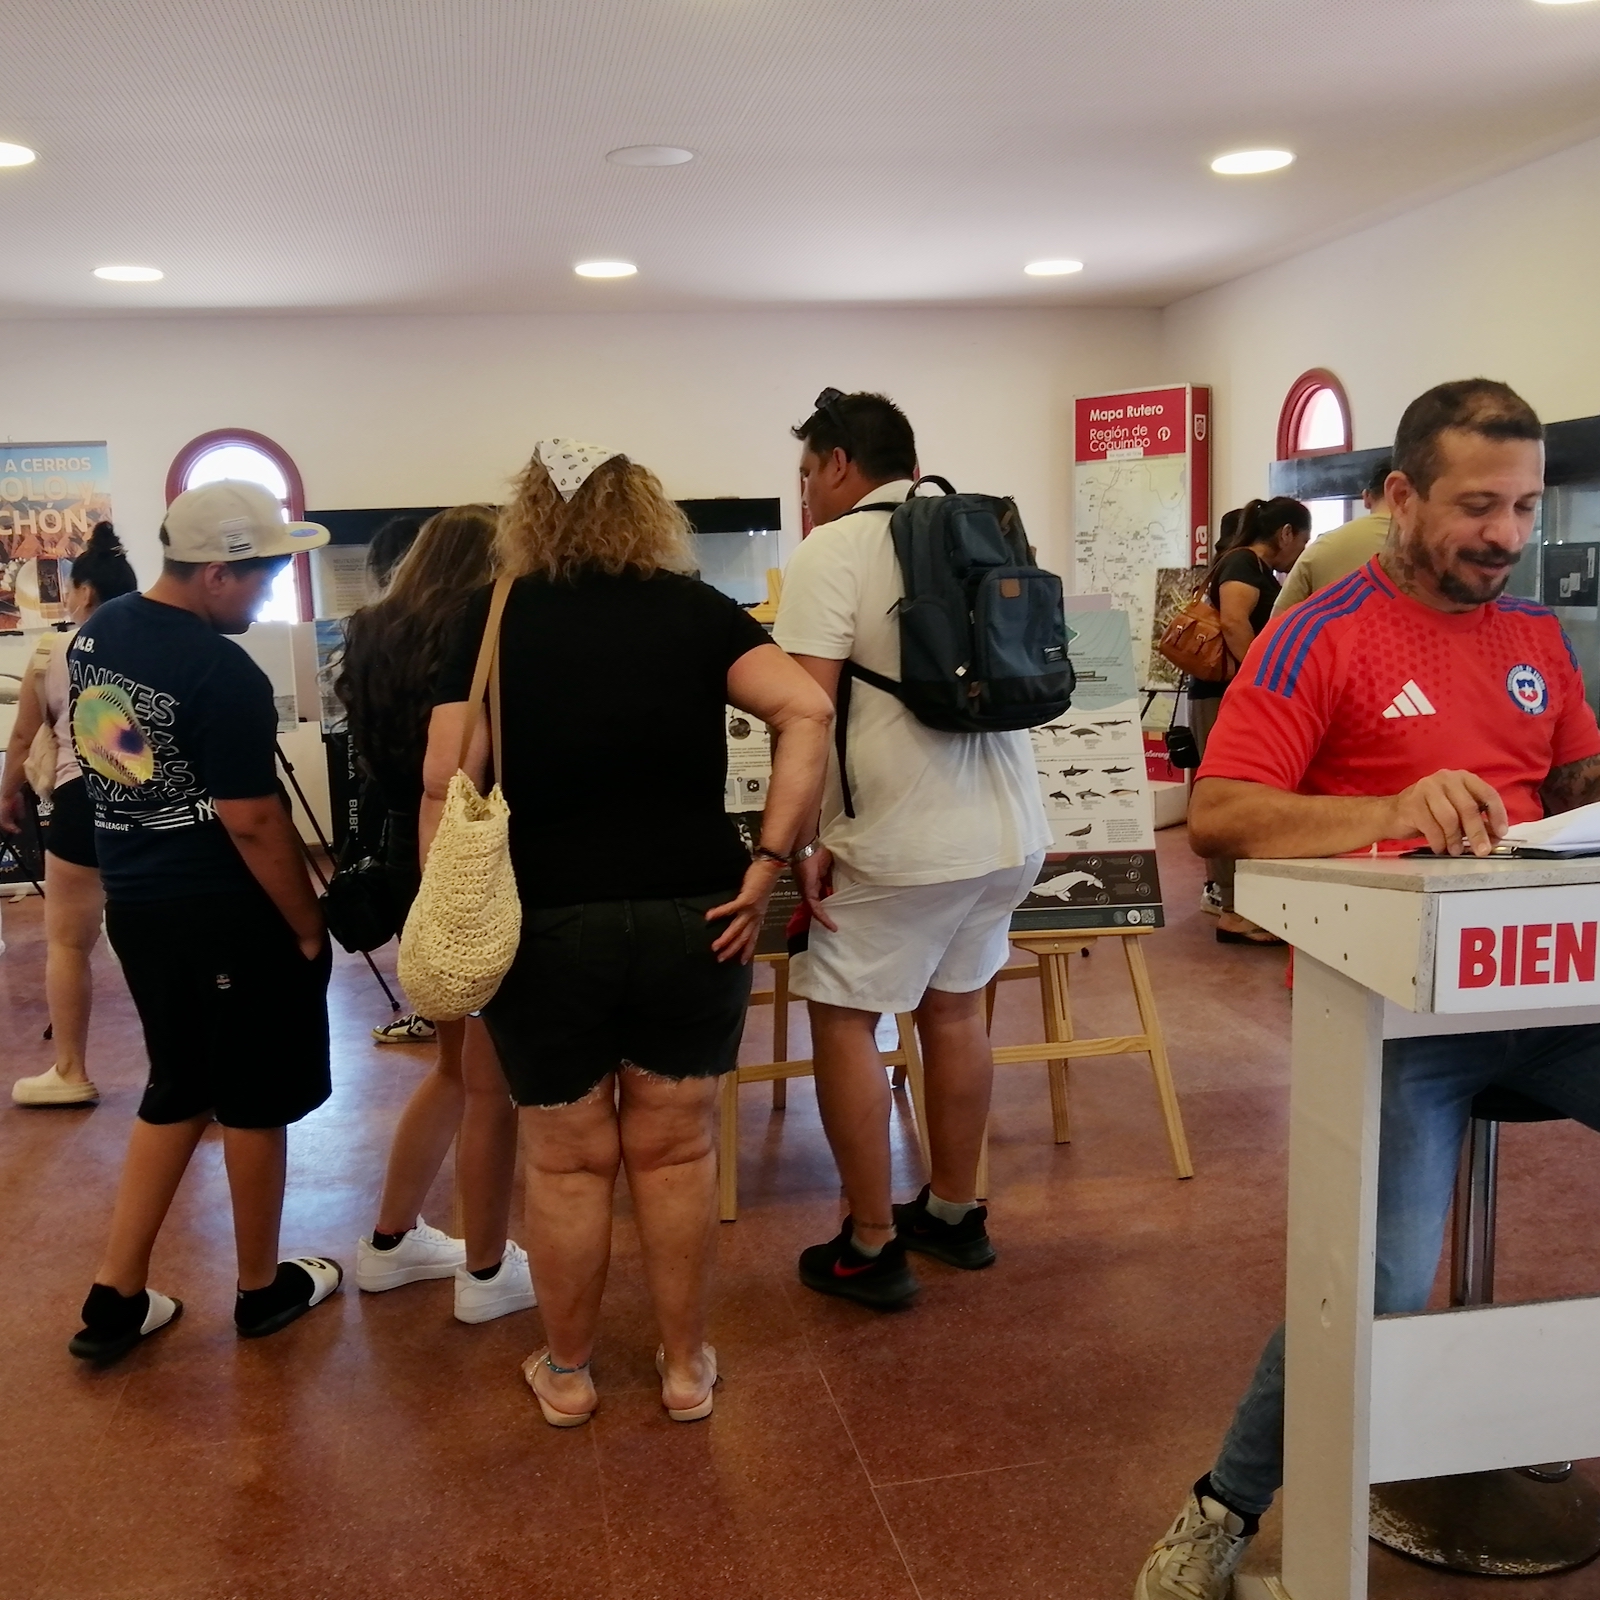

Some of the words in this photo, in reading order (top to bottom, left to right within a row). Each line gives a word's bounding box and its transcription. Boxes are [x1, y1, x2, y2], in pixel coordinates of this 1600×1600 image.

[1089, 409, 1124, 422] Mapa
[1126, 404, 1164, 418] Rutero
[1089, 425, 1129, 441] Región
[1131, 424, 1148, 437] de
[5, 459, 18, 473] A
[21, 457, 92, 472] CERROS
[105, 821, 130, 832] LEAGUE
[1458, 920, 1598, 990] BIEN
